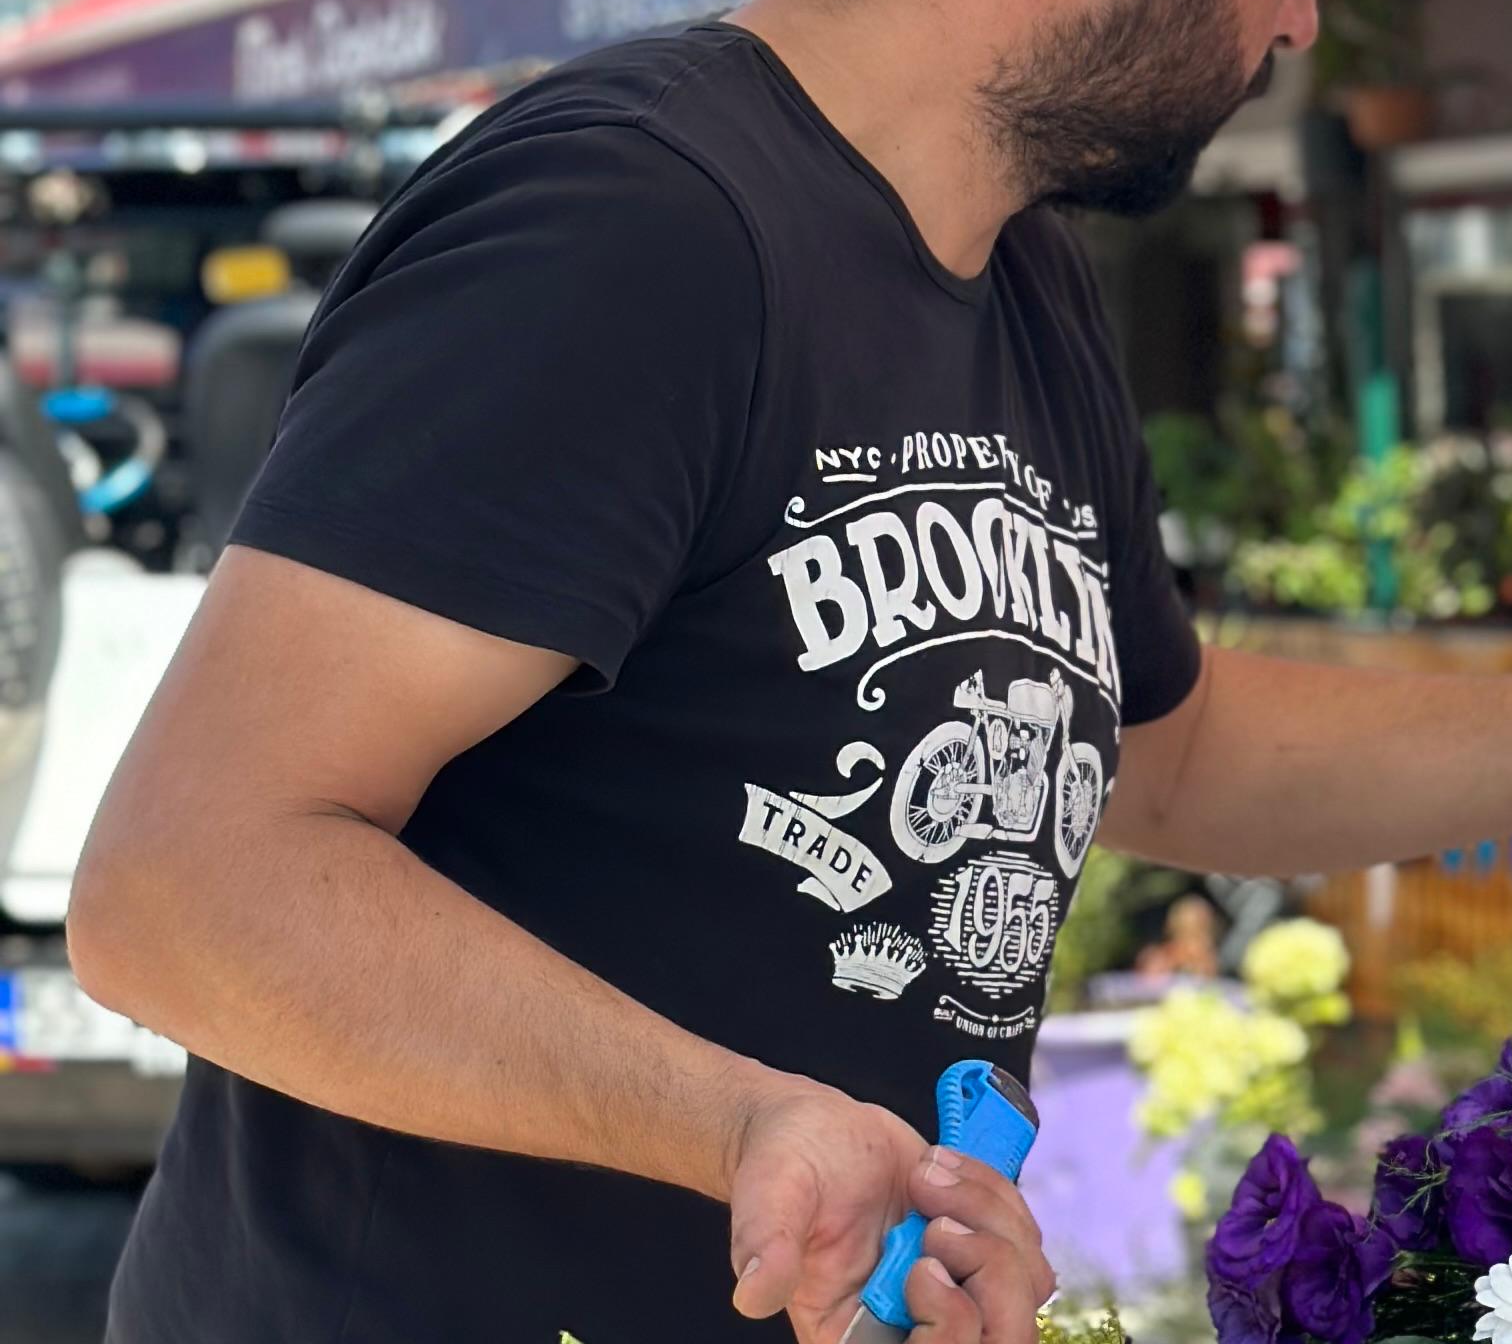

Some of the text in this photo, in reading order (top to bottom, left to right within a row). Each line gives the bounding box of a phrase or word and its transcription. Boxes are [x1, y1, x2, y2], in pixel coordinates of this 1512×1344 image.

[815, 446, 881, 471] NYC
[1024, 464, 1052, 511] OF
[762, 801, 873, 894] TRADE
[943, 865, 1055, 973] 1955
[955, 1015, 985, 1037] UNION
